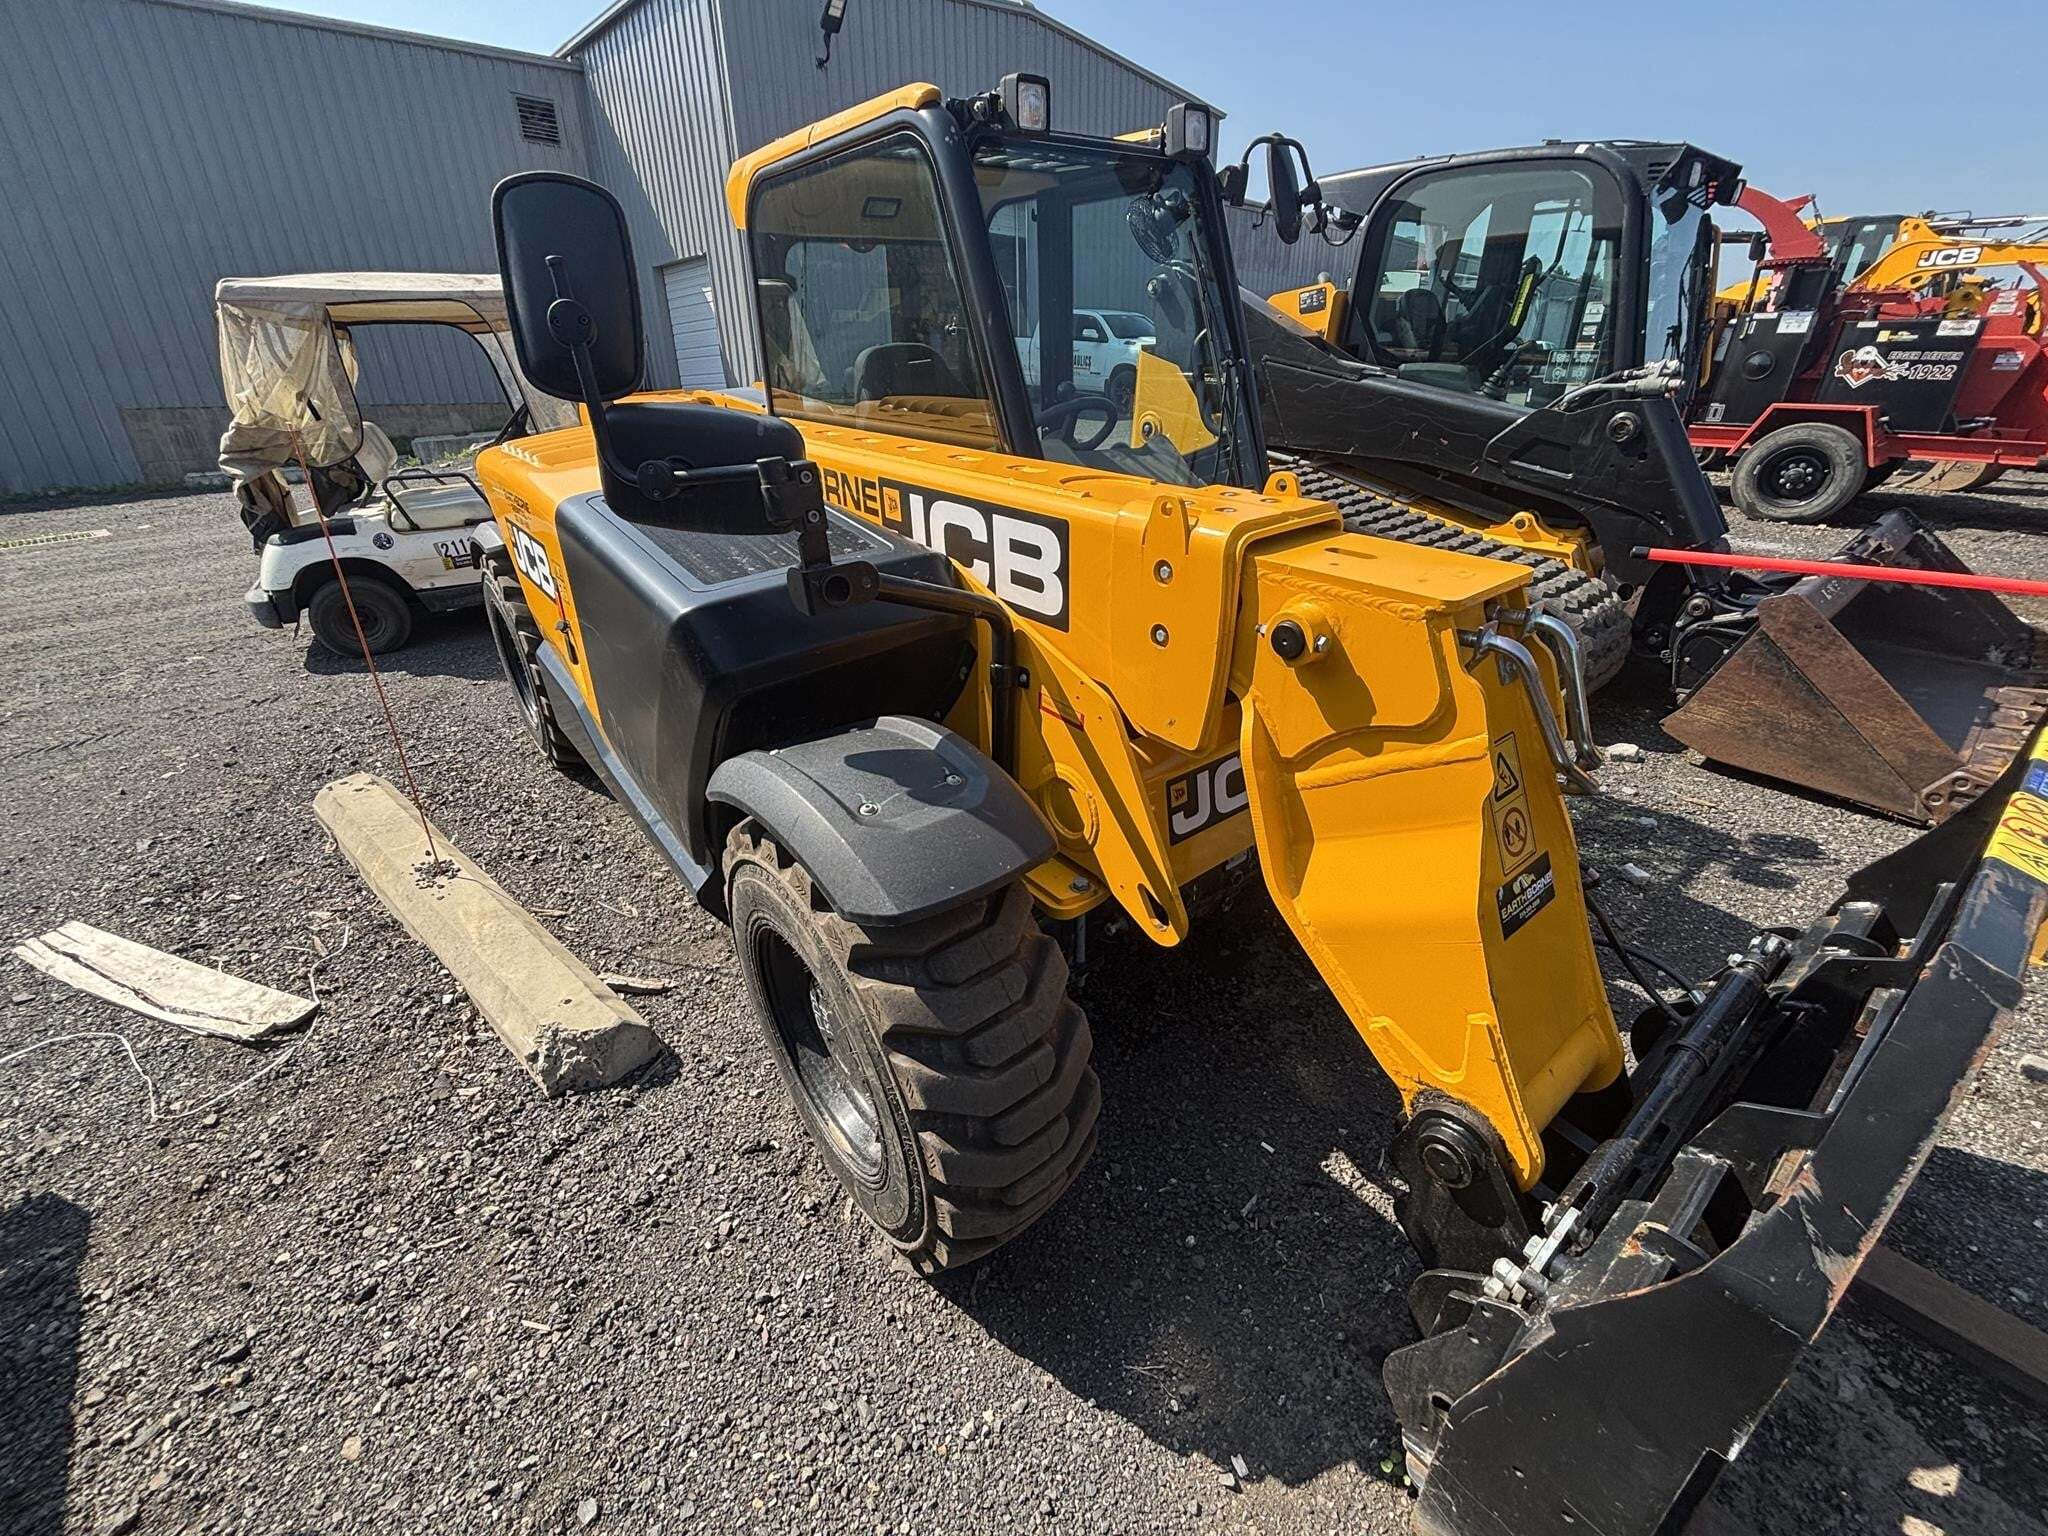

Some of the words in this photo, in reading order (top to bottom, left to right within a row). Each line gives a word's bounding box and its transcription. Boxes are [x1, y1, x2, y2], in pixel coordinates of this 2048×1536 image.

[1918, 247, 1982, 267] JCB
[1073, 354, 1091, 368] AULICS
[1908, 364, 1958, 381] 1922
[823, 467, 880, 517] RNE
[512, 526, 556, 600] JCB
[909, 493, 1064, 617] JCB
[1172, 755, 1249, 835] JC
[1500, 870, 1553, 920] EARTHBORNE
